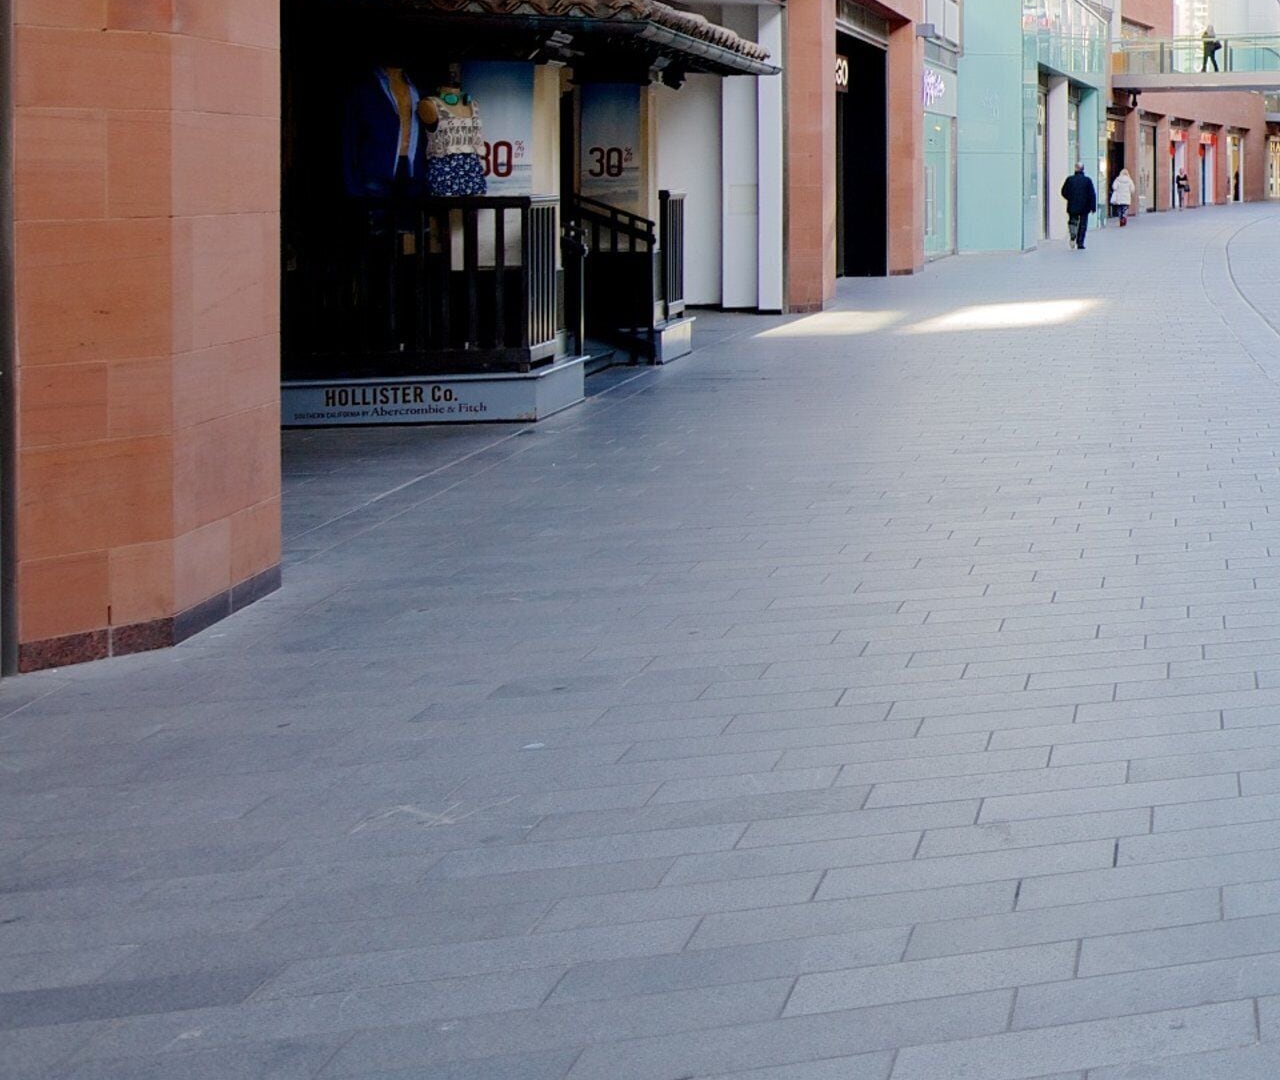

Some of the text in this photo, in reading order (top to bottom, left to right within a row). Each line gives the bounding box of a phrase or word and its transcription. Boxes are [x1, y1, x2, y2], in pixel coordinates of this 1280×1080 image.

[589, 147, 623, 177] 30
[325, 385, 458, 408] HOLLISTER Co.
[370, 405, 444, 418] Abercrombie
[458, 402, 487, 413] Fitch
